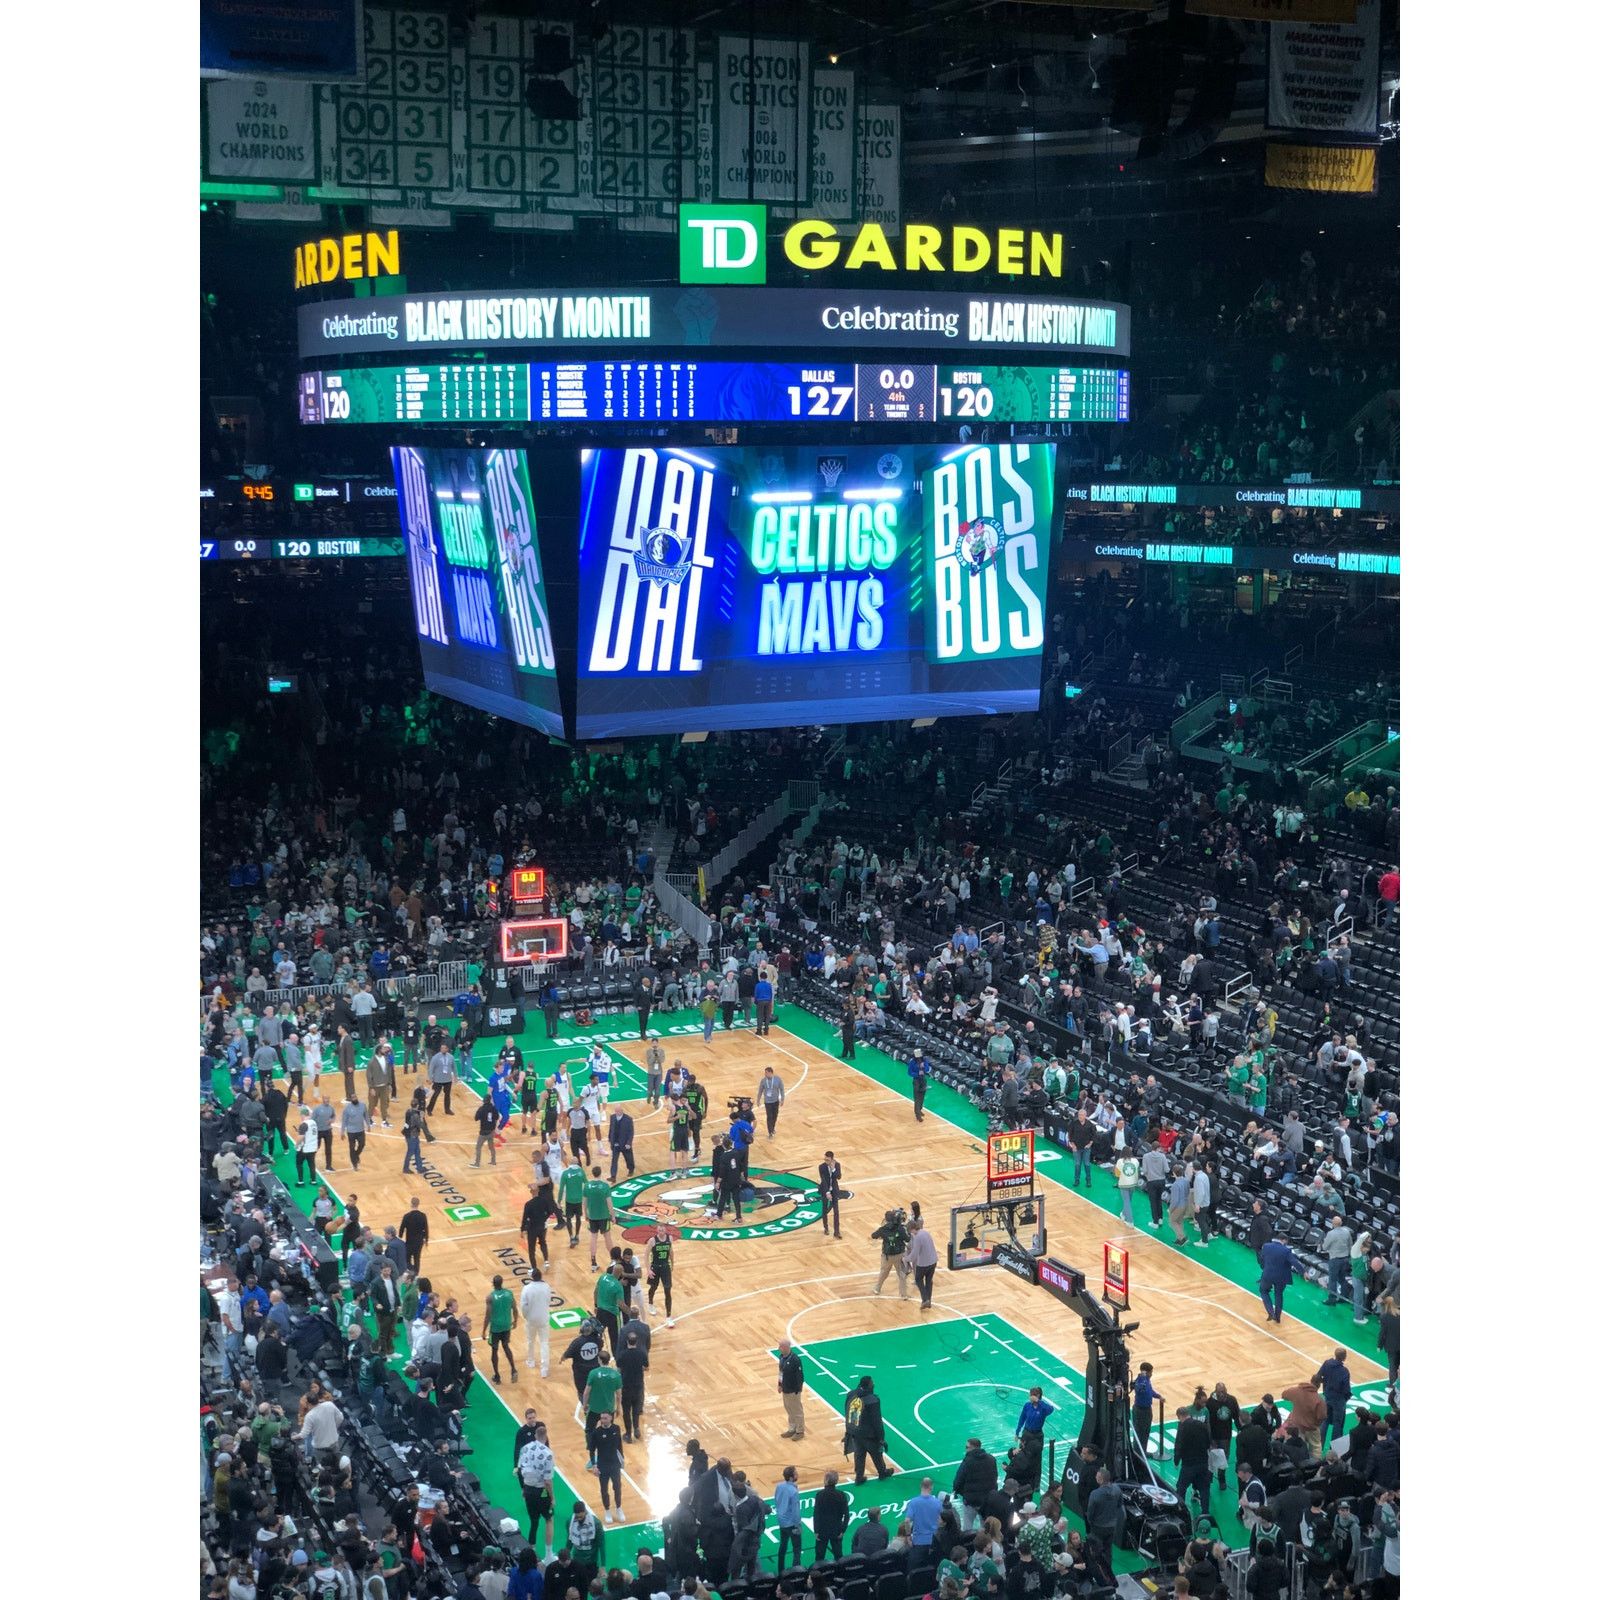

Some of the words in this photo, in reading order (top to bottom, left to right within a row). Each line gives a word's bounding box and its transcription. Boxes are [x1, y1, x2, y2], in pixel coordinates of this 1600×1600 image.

[398, 15, 445, 49] 33
[483, 21, 498, 54] 1
[399, 60, 446, 93] 35
[477, 64, 516, 98] 19
[727, 54, 799, 81] BOSTON
[600, 72, 641, 105] 23
[729, 81, 799, 108] CELTICS
[243, 102, 277, 118] 2024
[342, 101, 391, 136] 00
[404, 106, 443, 139] 31
[236, 122, 288, 139] WORLD
[476, 109, 516, 142] 17
[602, 116, 639, 150] 21
[221, 142, 305, 161] CHAMPIONS
[345, 148, 391, 181] 34
[742, 149, 786, 165] WORLD
[414, 152, 433, 182] 5
[477, 153, 516, 187] 10
[539, 156, 560, 189] 2
[601, 160, 642, 194] 24
[727, 167, 799, 185] CHAMPIONS
[295, 231, 400, 289] ARDEN
[688, 219, 759, 269] TD
[784, 220, 1063, 277] GARDEN
[322, 312, 398, 340] Celebrating
[405, 300, 463, 343] BLACK
[466, 298, 558, 340] HISTORY
[562, 296, 651, 338] MONTH
[822, 306, 959, 337] Celebrating
[968, 301, 1025, 343] BLACK
[1026, 303, 1084, 345] HISTORY
[1085, 309, 1116, 347] MONTH
[802, 370, 835, 383] DALLAS
[879, 369, 915, 389] 0.0
[953, 372, 982, 385] BOSTON
[322, 391, 351, 419] 120
[787, 386, 854, 416] 127
[940, 387, 994, 418] 120
[243, 485, 274, 500] 9:45
[296, 487, 312, 498] TD
[315, 488, 339, 497] Bank
[1090, 485, 1115, 502] BLACK
[1116, 486, 1148, 502] HISTORY
[1148, 486, 1177, 503] MONTH
[1236, 490, 1285, 504] Celebrating
[1287, 488, 1308, 507] BLACK
[1308, 489, 1336, 508] HISTORY
[1336, 490, 1361, 508] MONTH
[234, 540, 256, 551] 0.0
[278, 542, 311, 556] 120
[317, 541, 361, 555] BOSTON
[440, 502, 489, 570] CELTICS
[751, 502, 898, 574] CELTICS
[1095, 545, 1143, 559] Celebrating
[1146, 544, 1170, 561] BLACK
[1170, 545, 1203, 562] HISTORY
[1203, 546, 1233, 564] MONTH
[1293, 553, 1336, 567] Celebrating
[1338, 552, 1360, 571] BLACK
[1360, 554, 1388, 573] HISTORY
[639, 562, 684, 581] MAVERICKS
[453, 573, 498, 649] MAVS
[589, 548, 704, 672] DAL
[757, 577, 884, 655] MAVS
[552, 1028, 662, 1047] BOSTON
[1001, 1136, 1021, 1152] 0.0
[1003, 1176, 1032, 1187] TISSOT
[690, 1210, 820, 1240] BOSTON
[658, 1251, 667, 1259] 30
[581, 1347, 598, 1357] TNT
